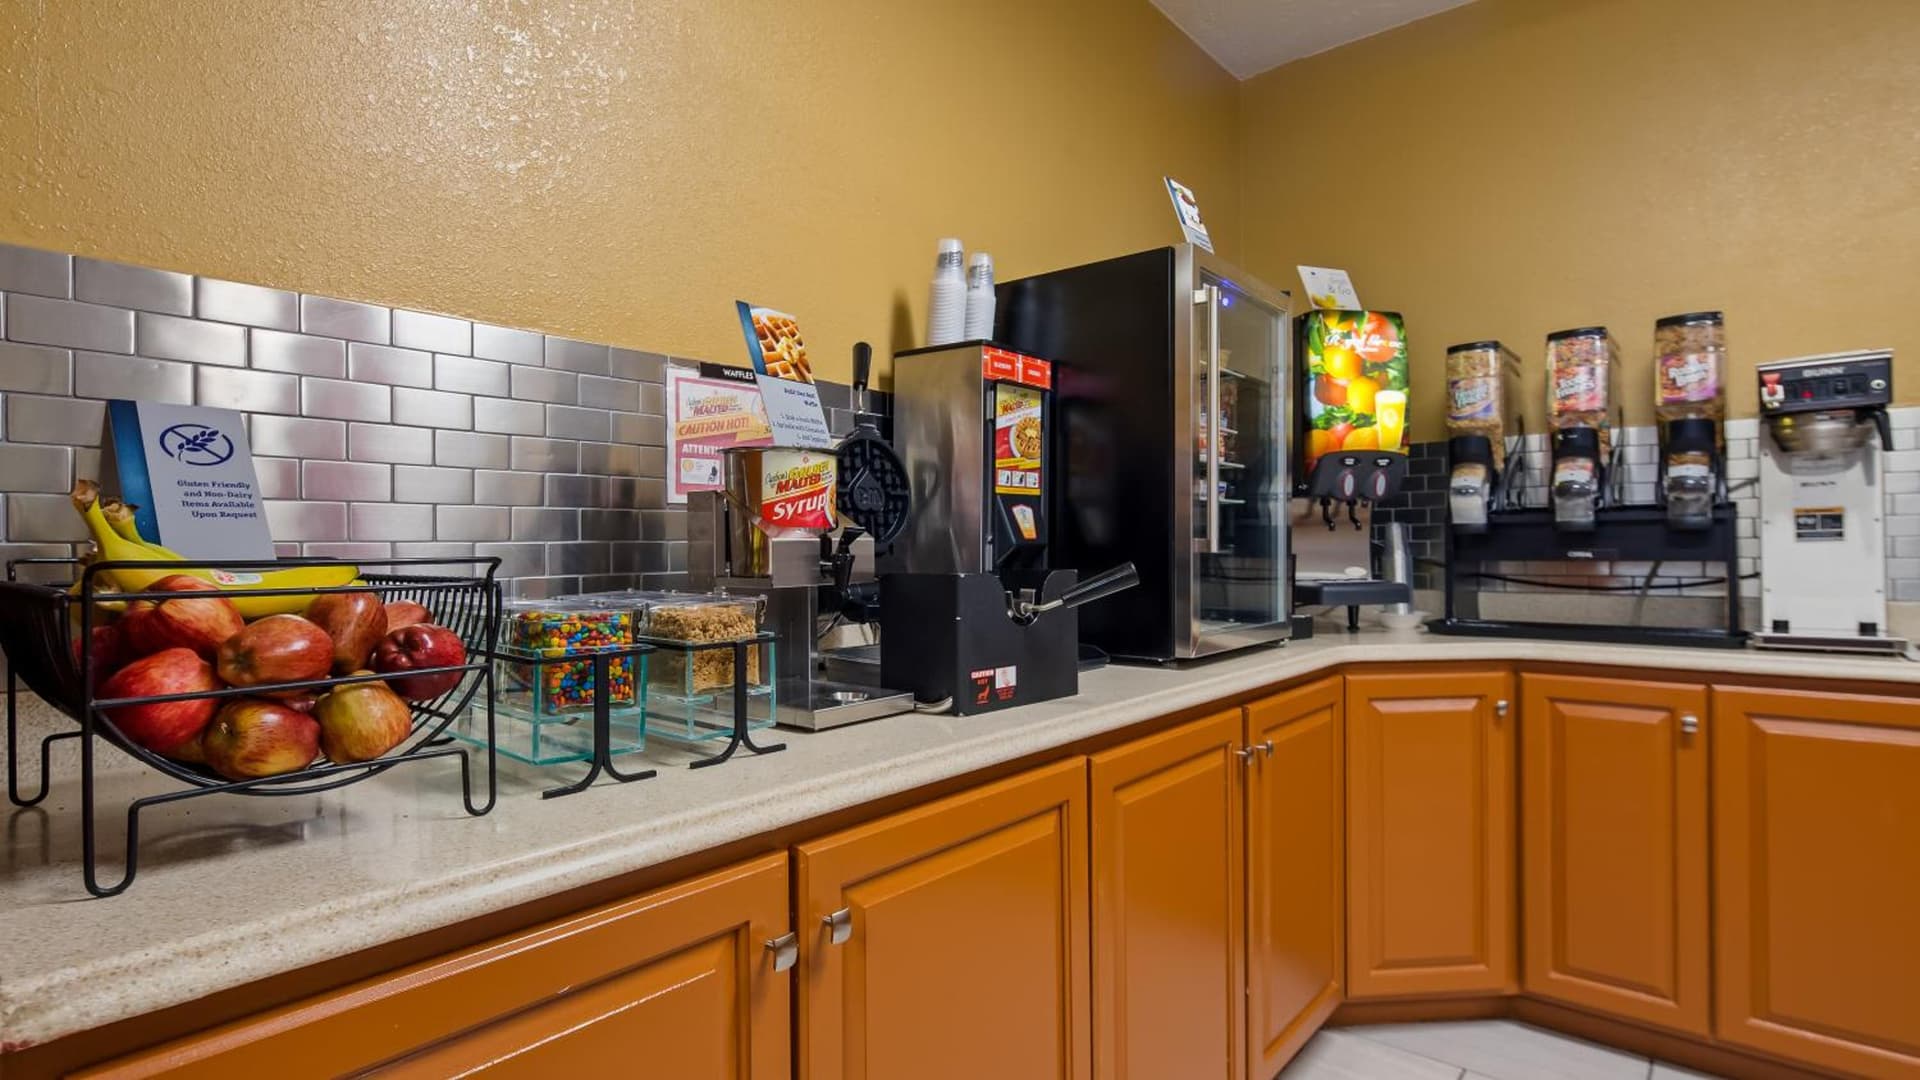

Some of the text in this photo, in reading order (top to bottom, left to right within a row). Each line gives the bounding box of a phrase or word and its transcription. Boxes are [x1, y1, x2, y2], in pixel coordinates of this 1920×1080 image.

[722, 368, 754, 380] WAFFLES
[680, 422, 725, 436] CAUTION
[727, 416, 750, 430] HOT!
[682, 443, 718, 455] ATTENT
[211, 481, 250, 490] Friendly
[776, 474, 821, 495] MALTED
[204, 490, 252, 500] Non-Dairy
[182, 500, 209, 508] Items
[772, 493, 827, 520] Syrup
[191, 510, 257, 519] Upon Request
